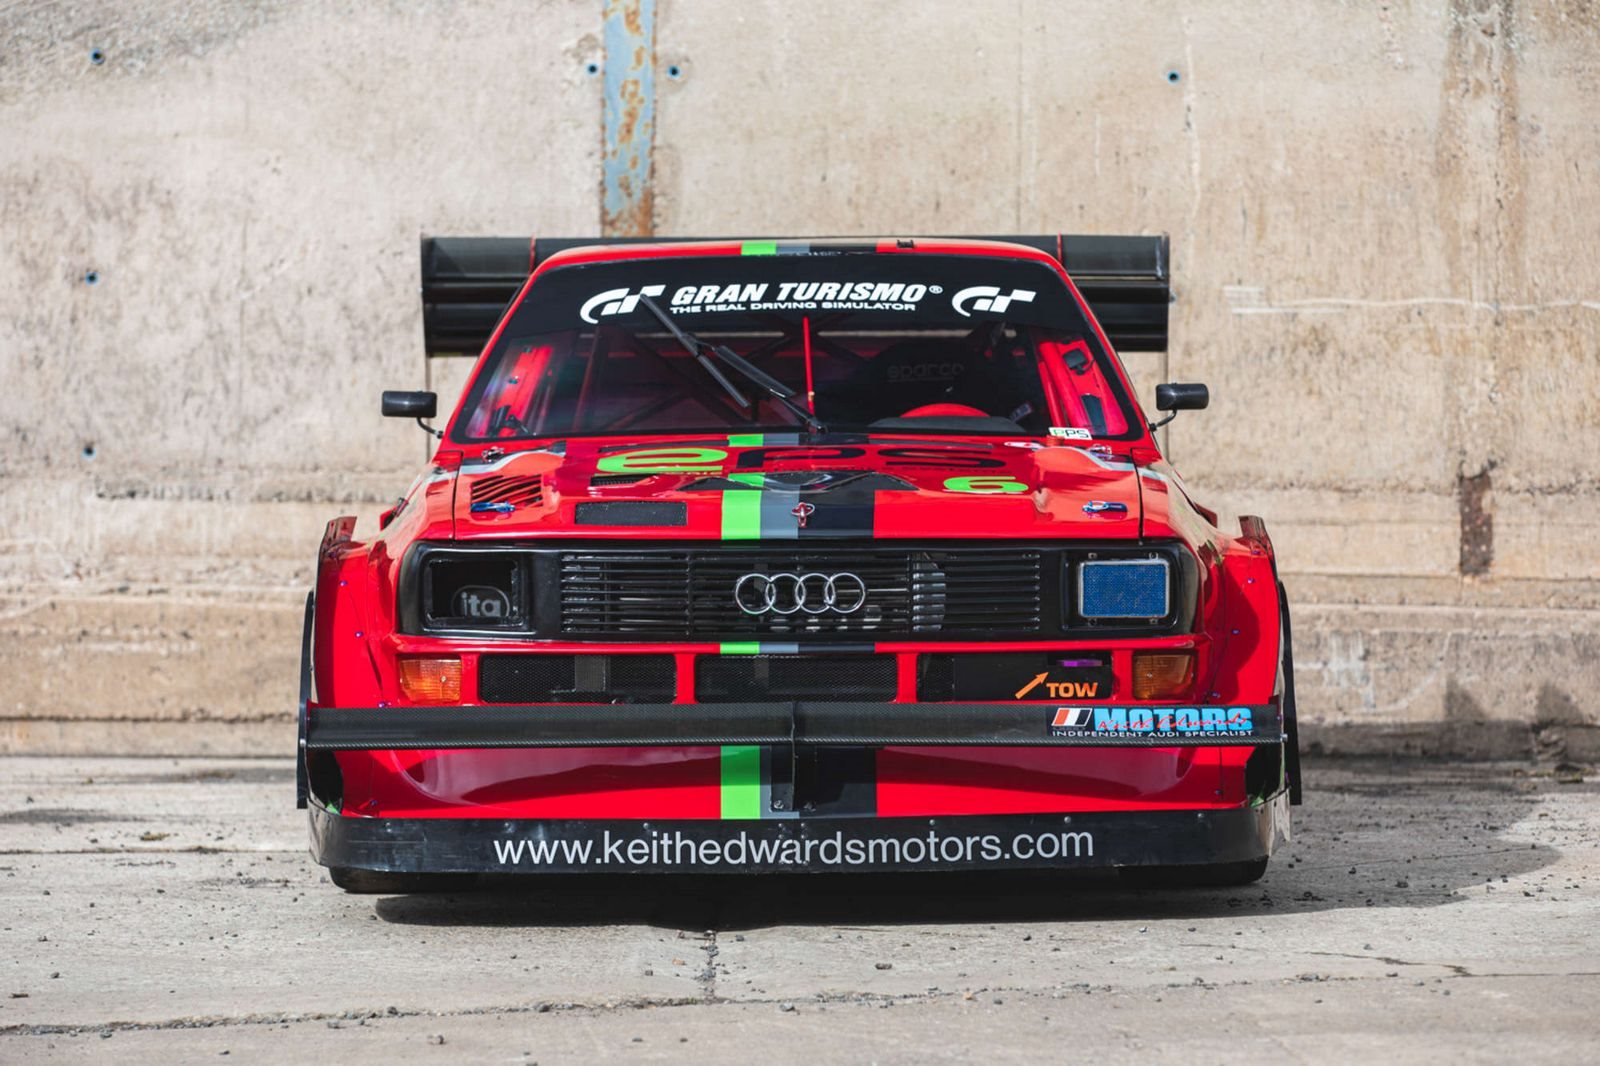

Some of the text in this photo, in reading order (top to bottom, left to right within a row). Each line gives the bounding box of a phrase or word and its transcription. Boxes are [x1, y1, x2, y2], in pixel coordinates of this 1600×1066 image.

[671, 283, 769, 305] GRAN
[669, 301, 916, 314] THE REAL DRIVING SIMULATOR
[1046, 682, 1098, 698] TOW
[1093, 707, 1252, 731] MOTORS
[493, 829, 1094, 865] www.keithedwardsmotors.com
